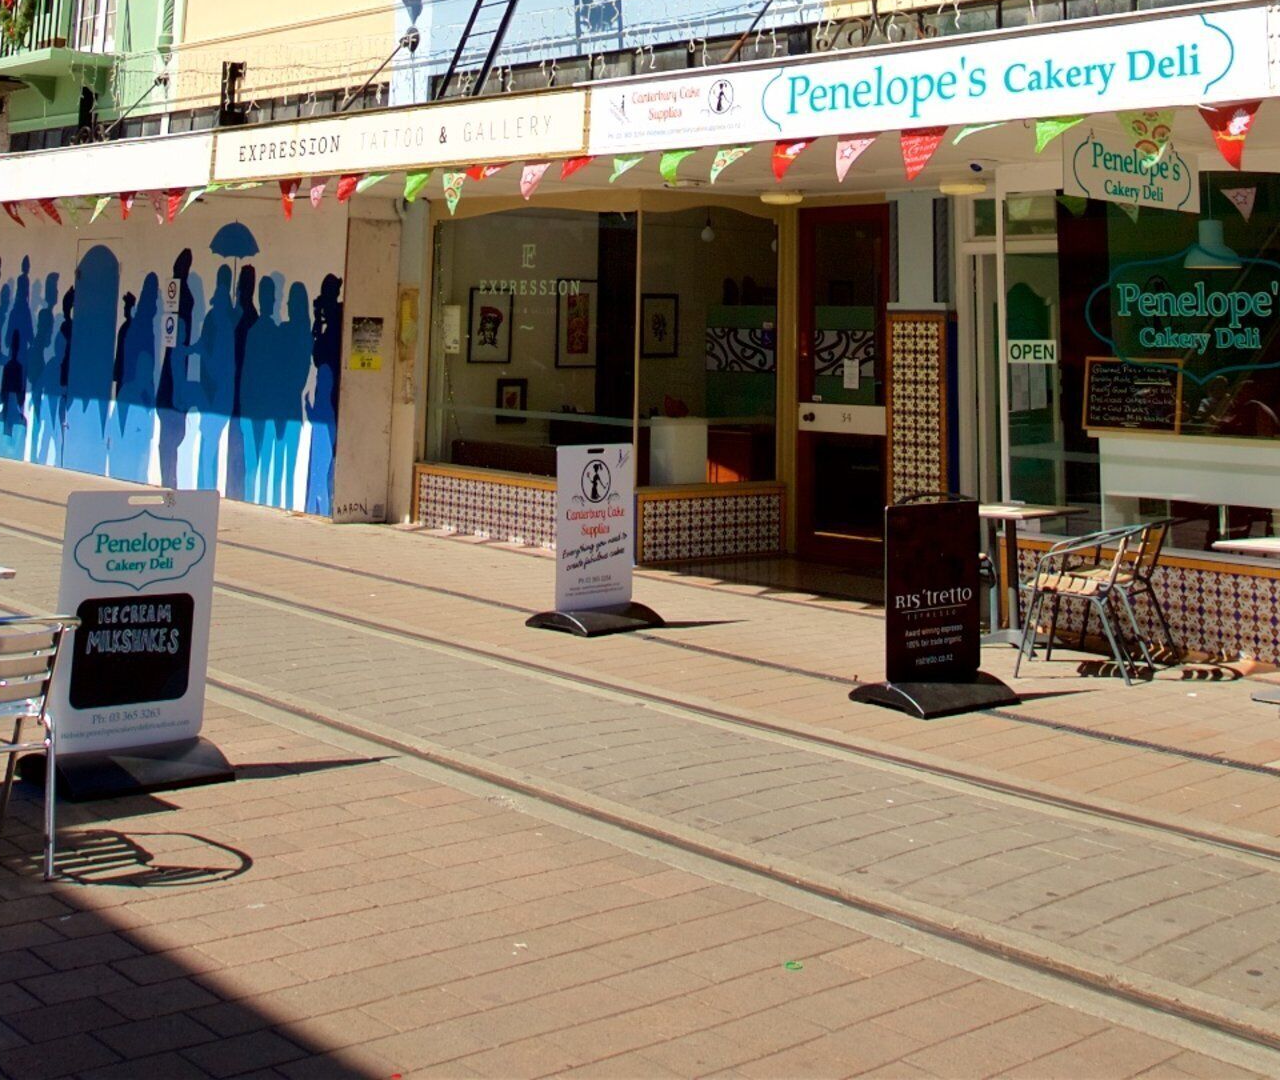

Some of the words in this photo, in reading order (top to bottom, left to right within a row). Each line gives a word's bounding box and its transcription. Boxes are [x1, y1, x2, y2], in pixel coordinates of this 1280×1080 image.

[787, 57, 988, 118] Penelope's
[1004, 59, 1116, 96] Cakery
[1127, 43, 1201, 82] Deli
[631, 90, 677, 104] Canterbury
[679, 86, 701, 100] Cake
[648, 107, 683, 122] Supplies
[238, 135, 341, 163] EXPRESSION
[360, 126, 425, 151] TATTOO
[438, 126, 448, 145] &
[463, 115, 554, 143] GALLERY
[1092, 142, 1181, 185] Penelope's
[1104, 179, 1140, 203] Cakery
[1143, 185, 1164, 202] Deli
[479, 280, 581, 296] EXPRESSION
[1140, 326, 1212, 354] Cakery
[1216, 328, 1262, 350] Deli
[1010, 344, 1055, 360] OPEN
[607, 504, 624, 517] Cake
[581, 522, 610, 538] Supplies
[95, 531, 196, 559] Penelope's
[106, 558, 147, 573] Cakery
[150, 557, 174, 571] Deli
[98, 606, 119, 624] ICE
[119, 604, 172, 624] CREAM
[85, 627, 180, 655] MILKSHAKES
